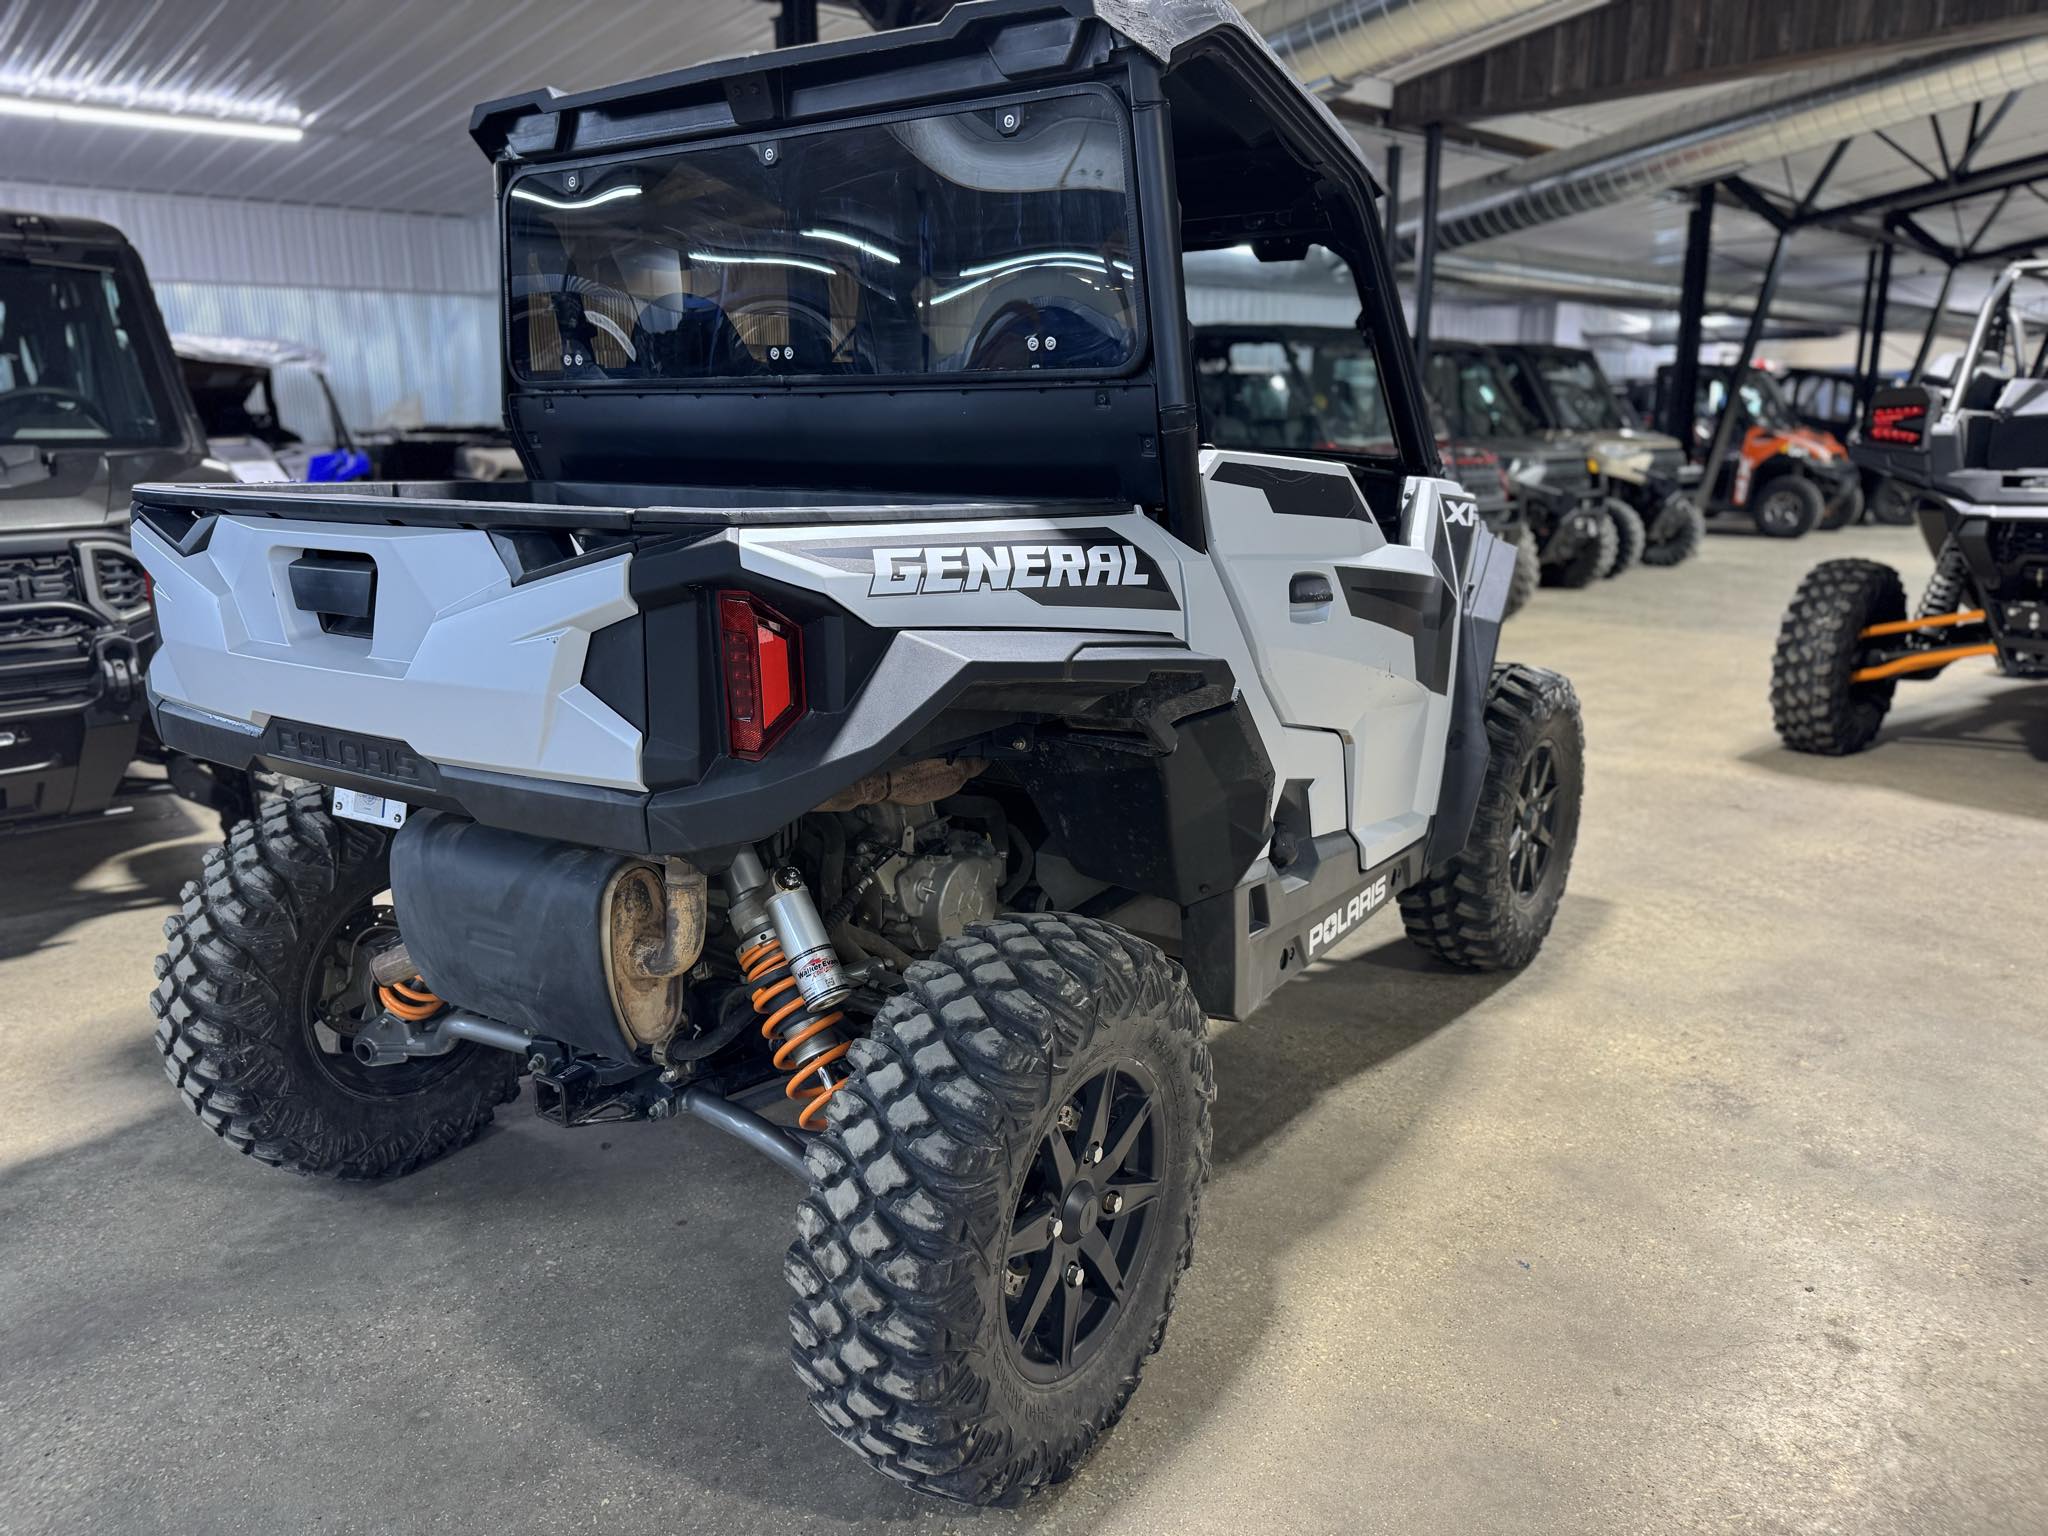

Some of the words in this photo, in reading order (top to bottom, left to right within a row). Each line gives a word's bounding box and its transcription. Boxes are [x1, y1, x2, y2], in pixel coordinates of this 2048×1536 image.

[868, 545, 1149, 597] GENERAL
[277, 726, 419, 781] POLARIS
[1309, 874, 1386, 956] POLARIS
